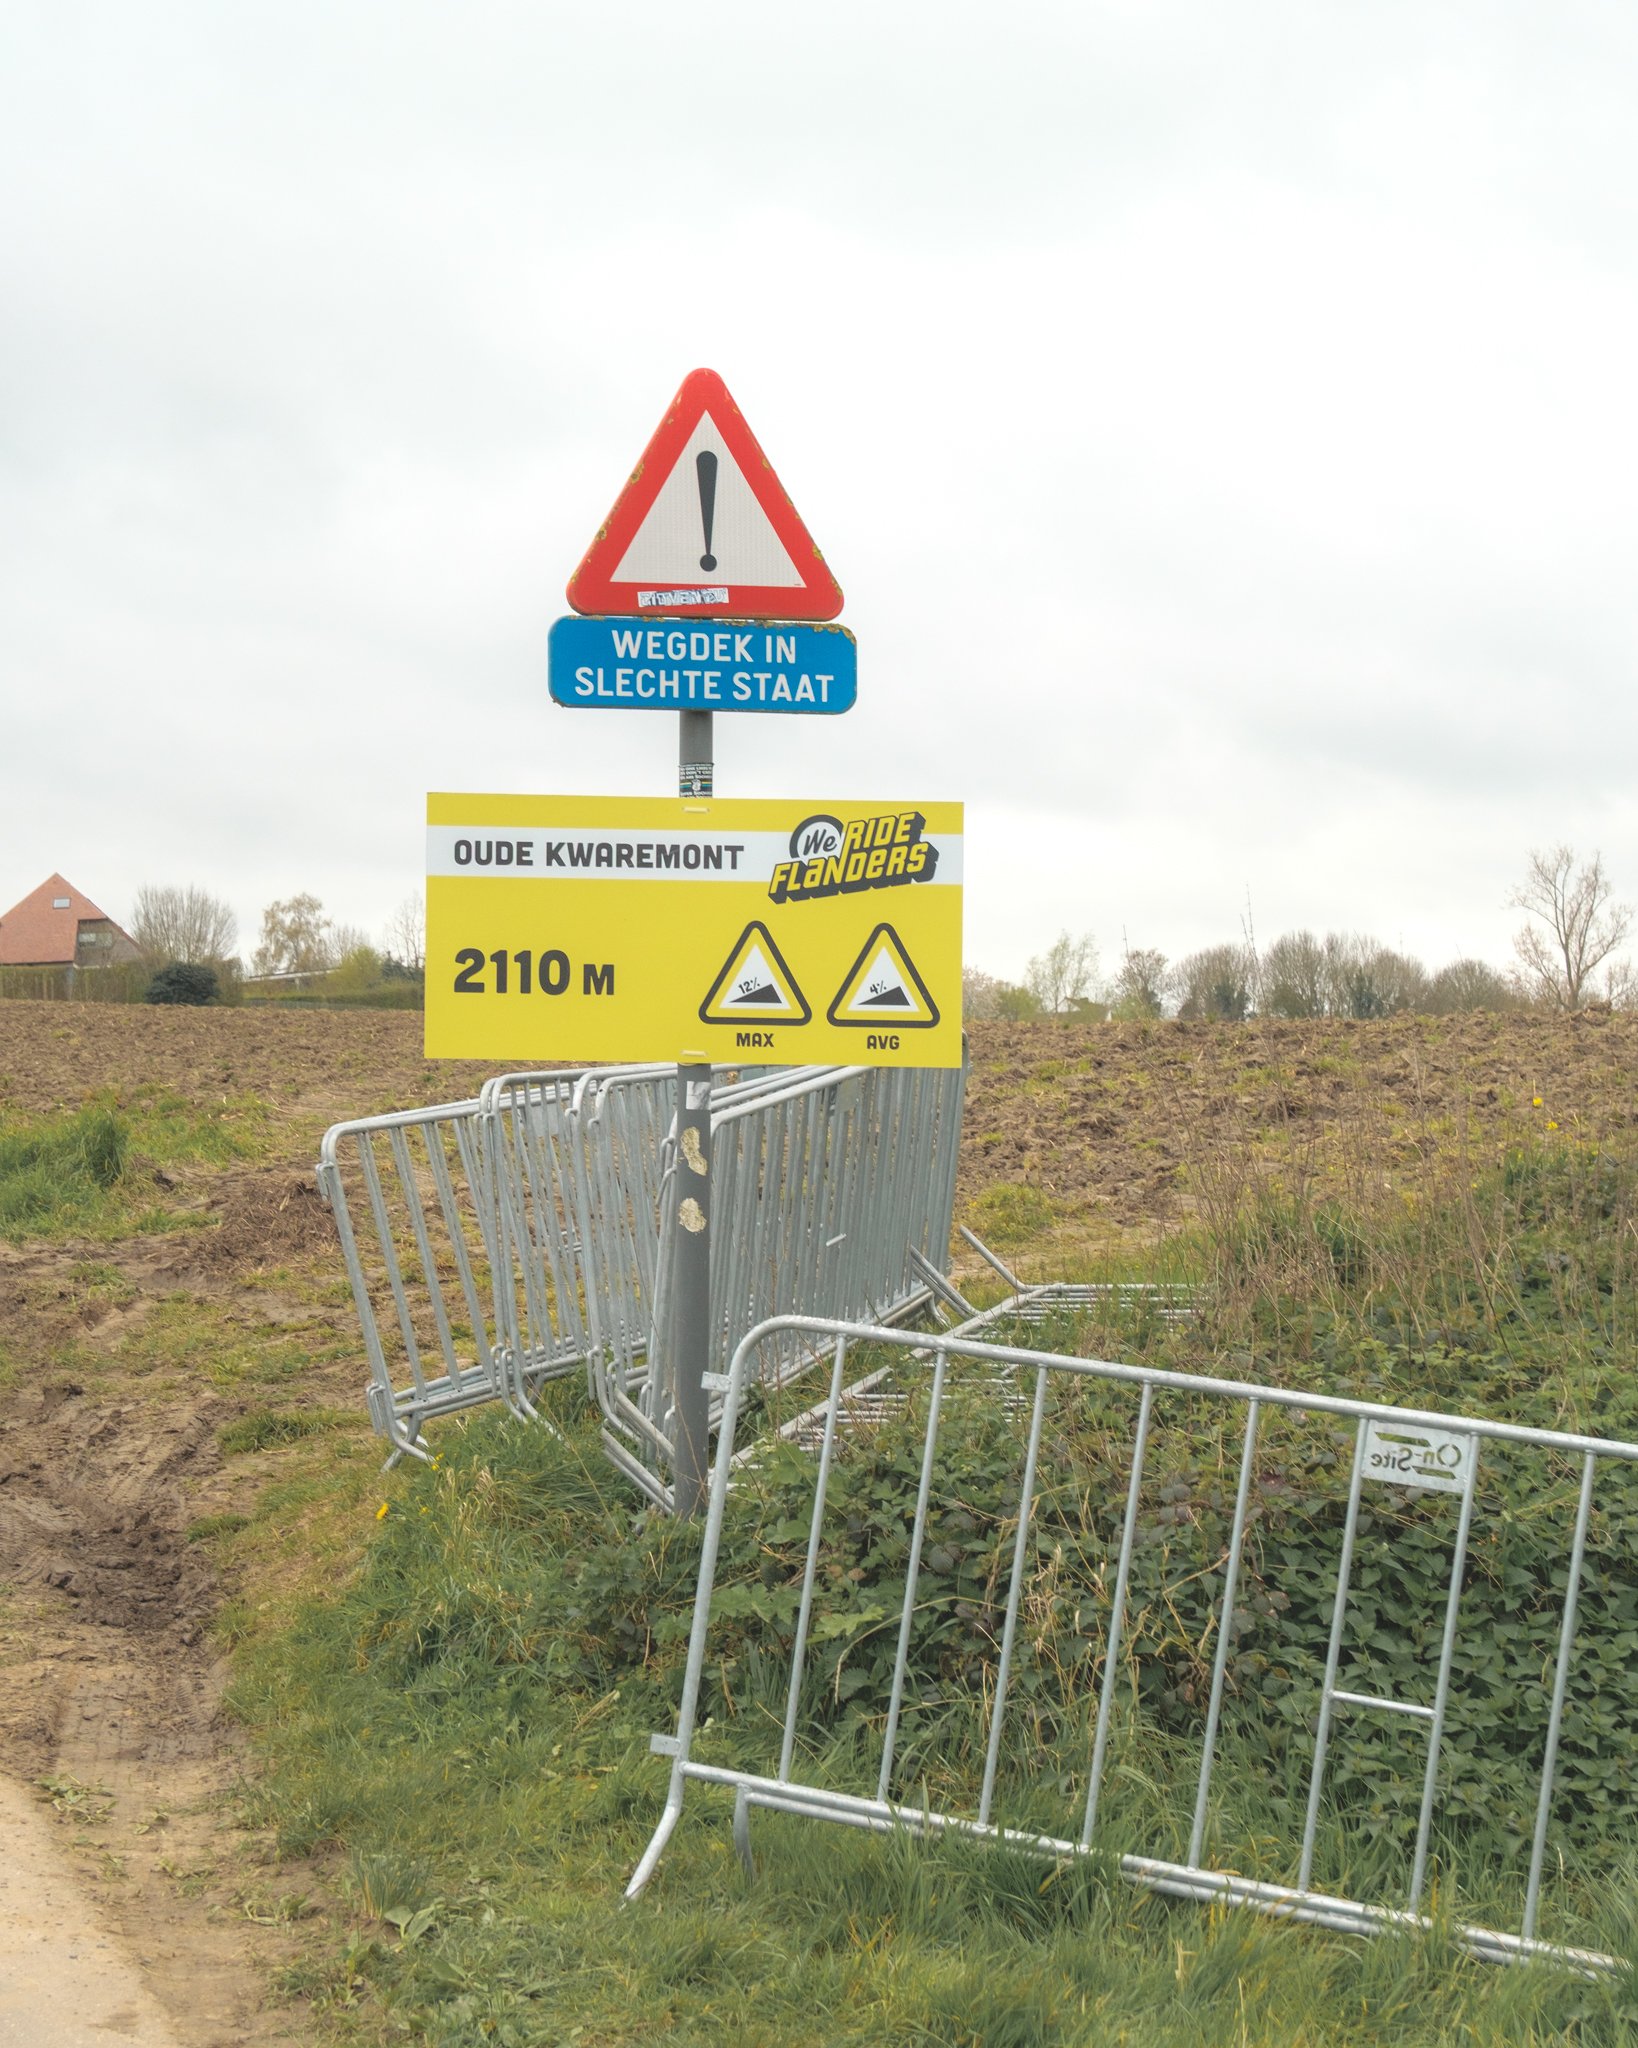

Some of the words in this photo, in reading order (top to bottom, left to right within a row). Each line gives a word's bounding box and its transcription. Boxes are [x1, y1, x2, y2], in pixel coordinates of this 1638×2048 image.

[611, 630, 754, 663] WEGDEK
[765, 635, 796, 664] IN
[575, 666, 721, 699] SLECHTE
[732, 672, 834, 703] STAAT
[803, 829, 838, 856] We
[843, 812, 918, 850] RIDE
[454, 839, 534, 867] OUDE
[546, 841, 745, 870] KWAREMONT
[453, 947, 571, 996] 2110
[582, 963, 615, 996] M
[738, 977, 761, 994] 12%
[869, 980, 887, 995] 4%
[735, 1032, 774, 1048] MAX
[866, 1034, 900, 1050] AVG
